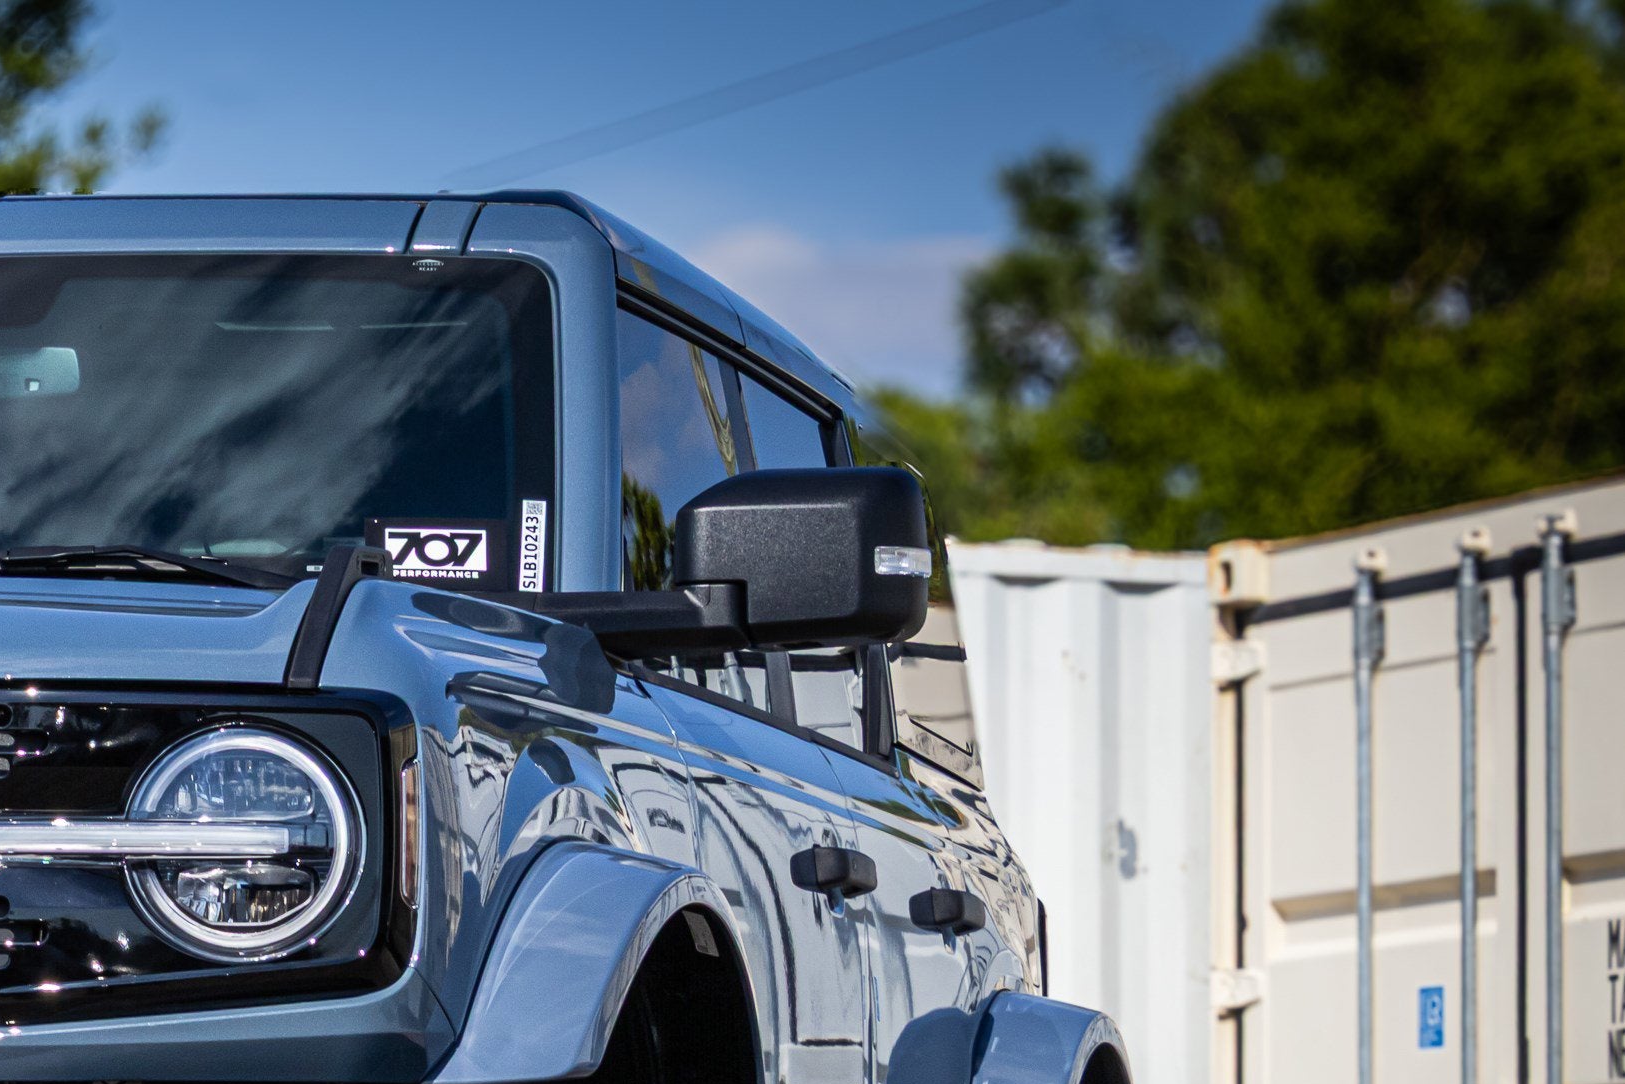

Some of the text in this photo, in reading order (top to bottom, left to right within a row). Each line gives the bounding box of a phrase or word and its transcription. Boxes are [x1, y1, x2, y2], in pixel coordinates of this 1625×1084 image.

[388, 531, 483, 567] 707
[522, 515, 539, 589] SLB10243
[392, 569, 480, 579] PERFORMANCE
